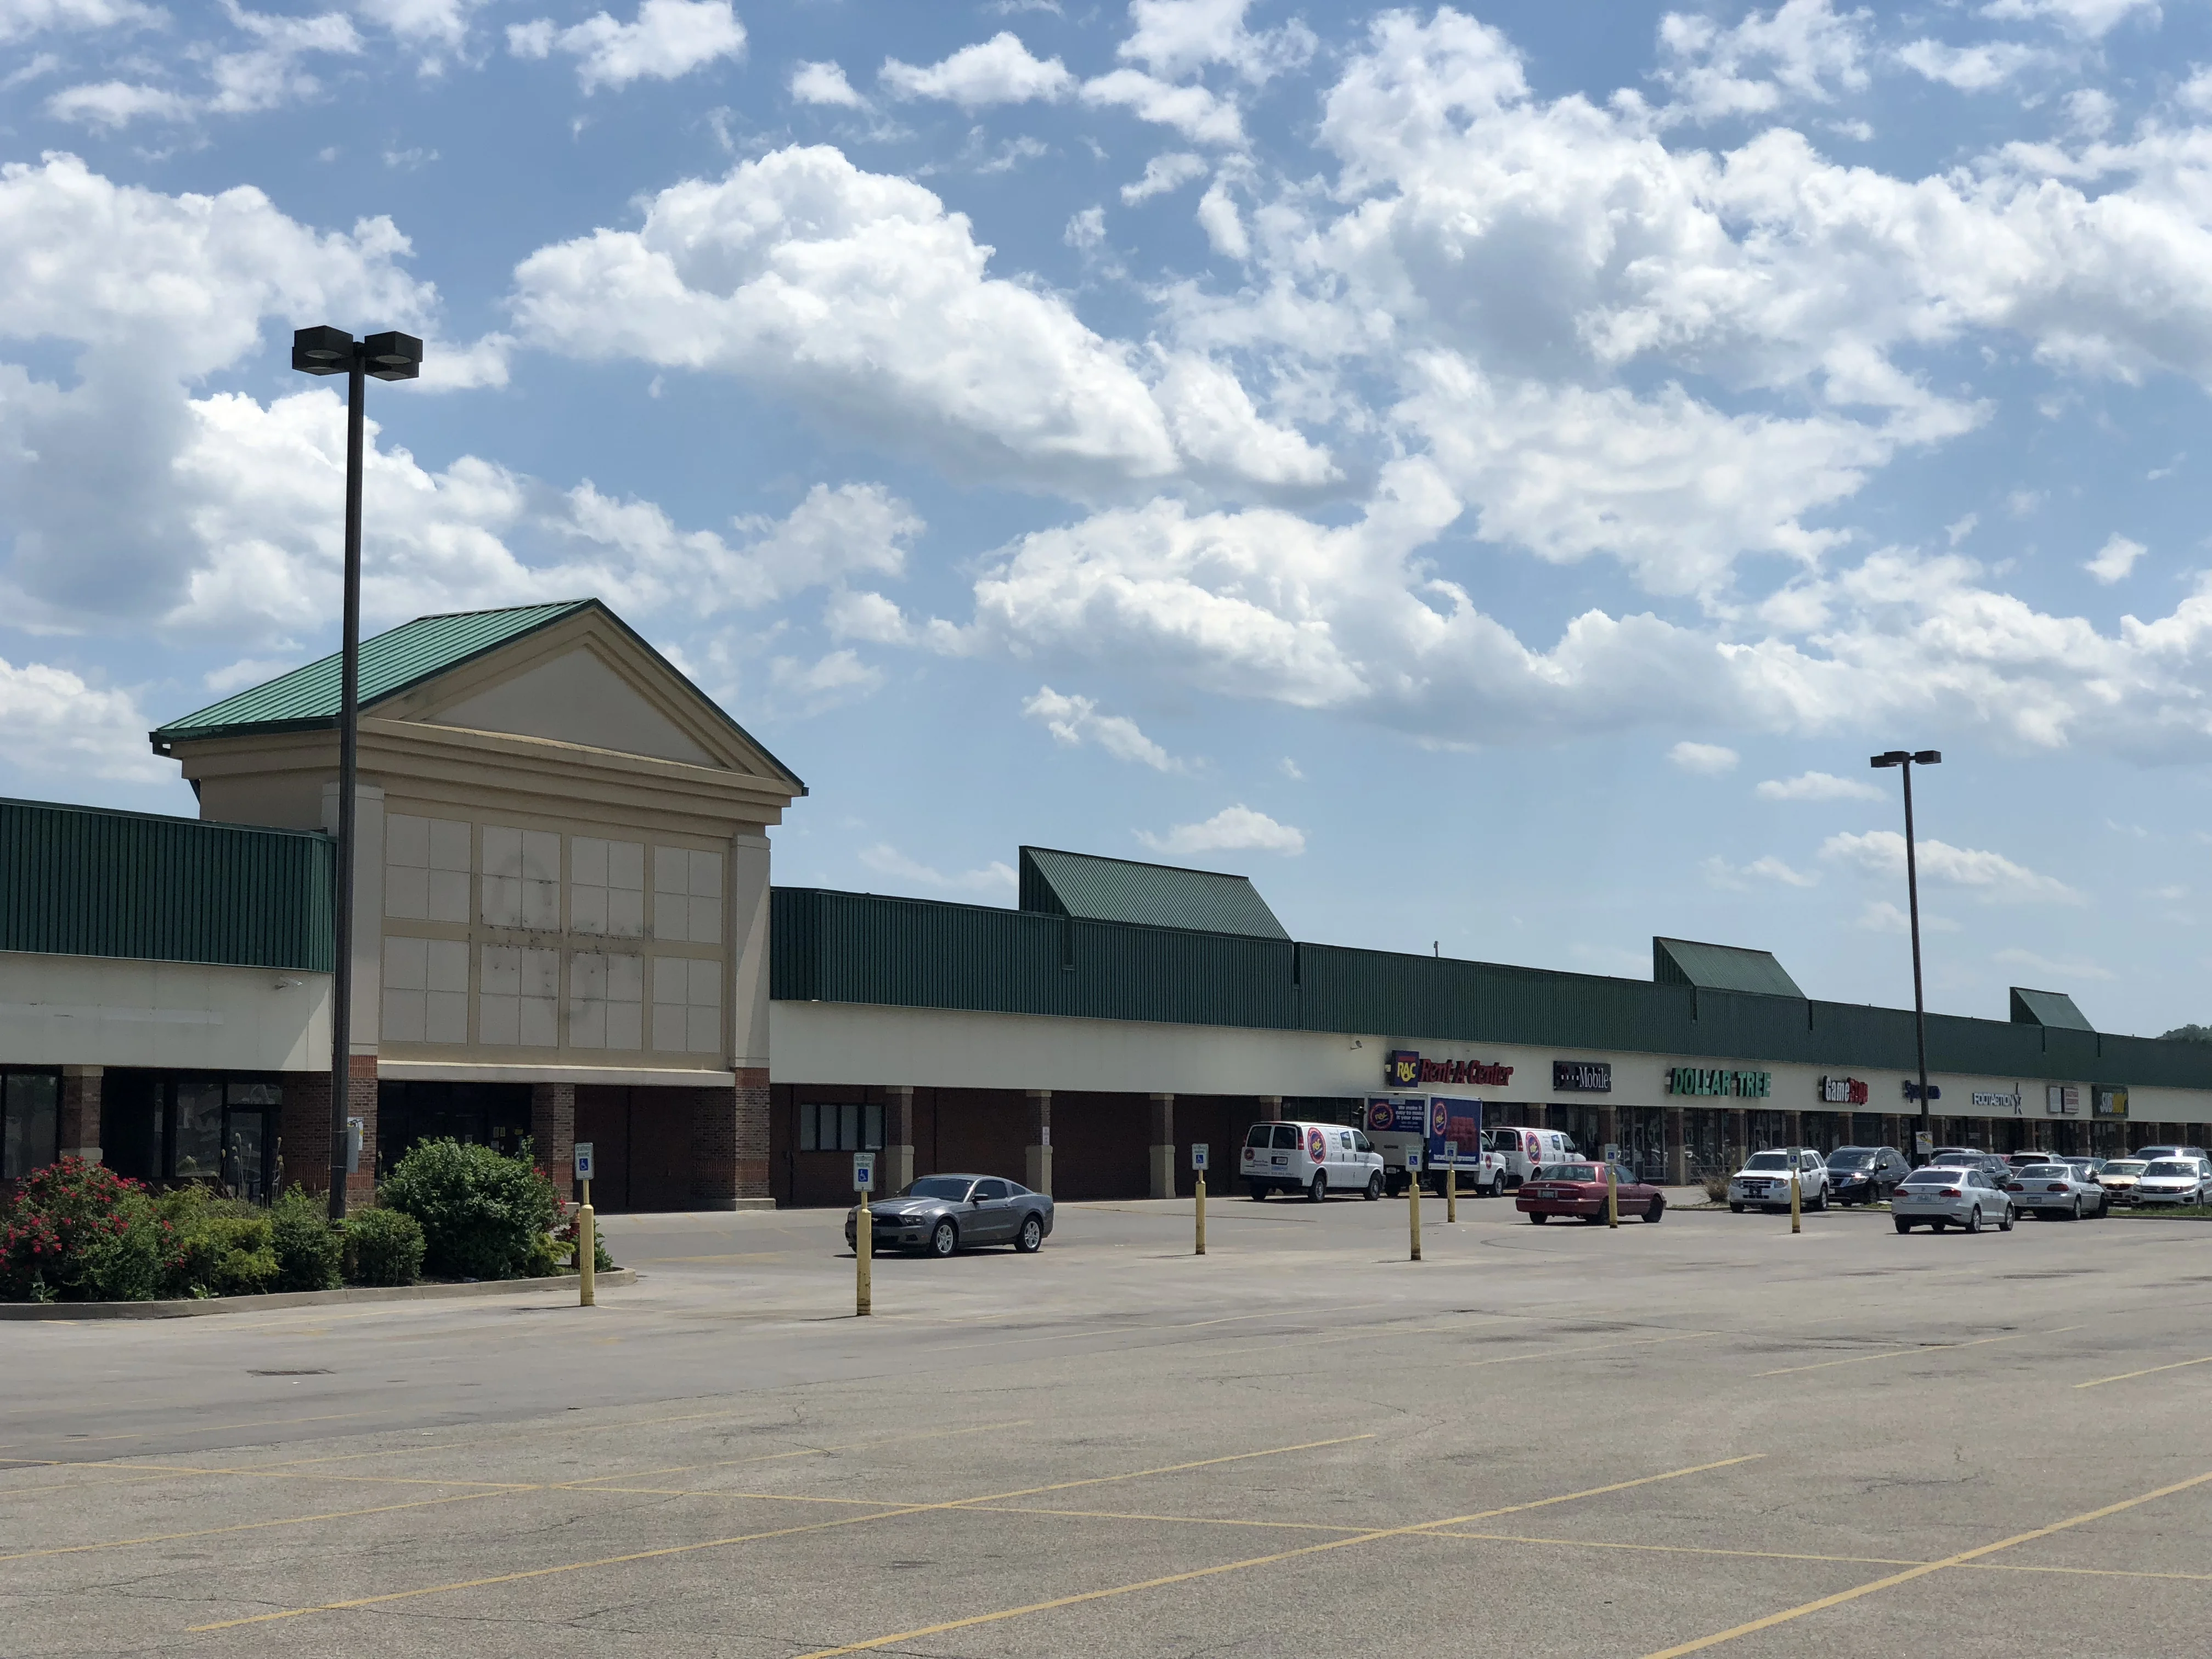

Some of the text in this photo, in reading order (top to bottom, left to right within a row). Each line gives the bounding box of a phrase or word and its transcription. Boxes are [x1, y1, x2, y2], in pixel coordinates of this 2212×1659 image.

[1397, 1062, 1416, 1082] RAC
[1419, 1059, 1514, 1086] Rent-A-Center
[1672, 1068, 1771, 1097] DOLLAR TREE
